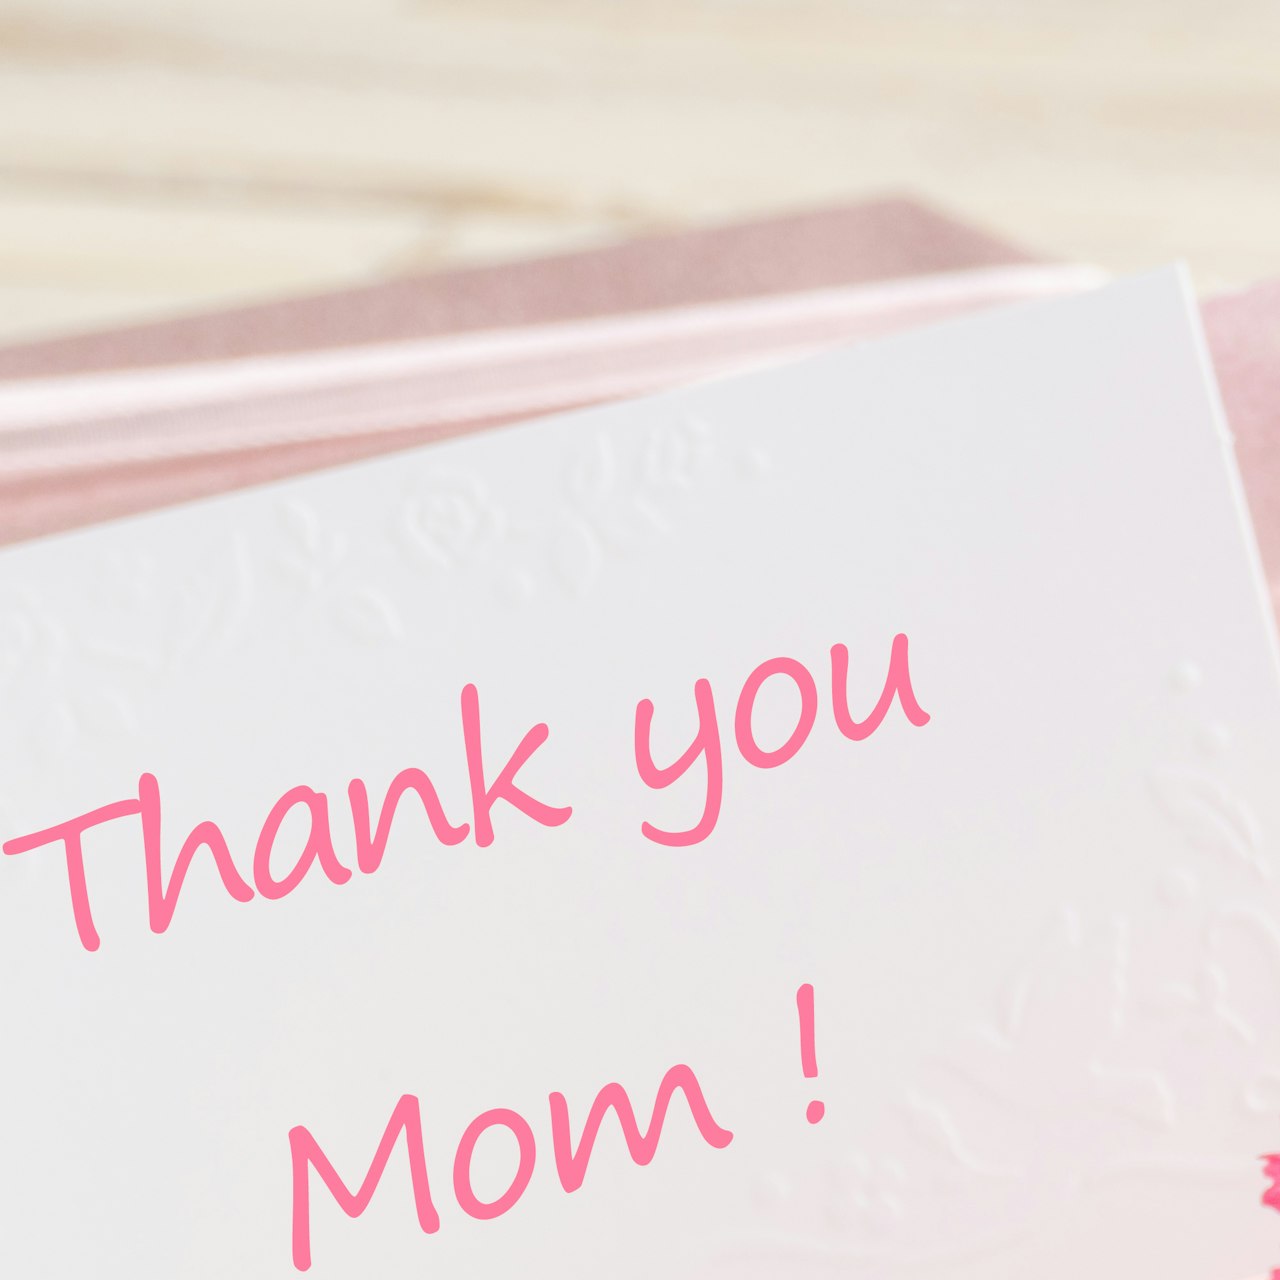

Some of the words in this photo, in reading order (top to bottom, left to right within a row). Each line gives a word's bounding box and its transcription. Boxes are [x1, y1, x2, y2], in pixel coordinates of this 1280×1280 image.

[3, 683, 572, 952] Thank
[635, 633, 930, 847] you
[288, 1064, 733, 1272] Mom
[796, 984, 825, 1124] !
